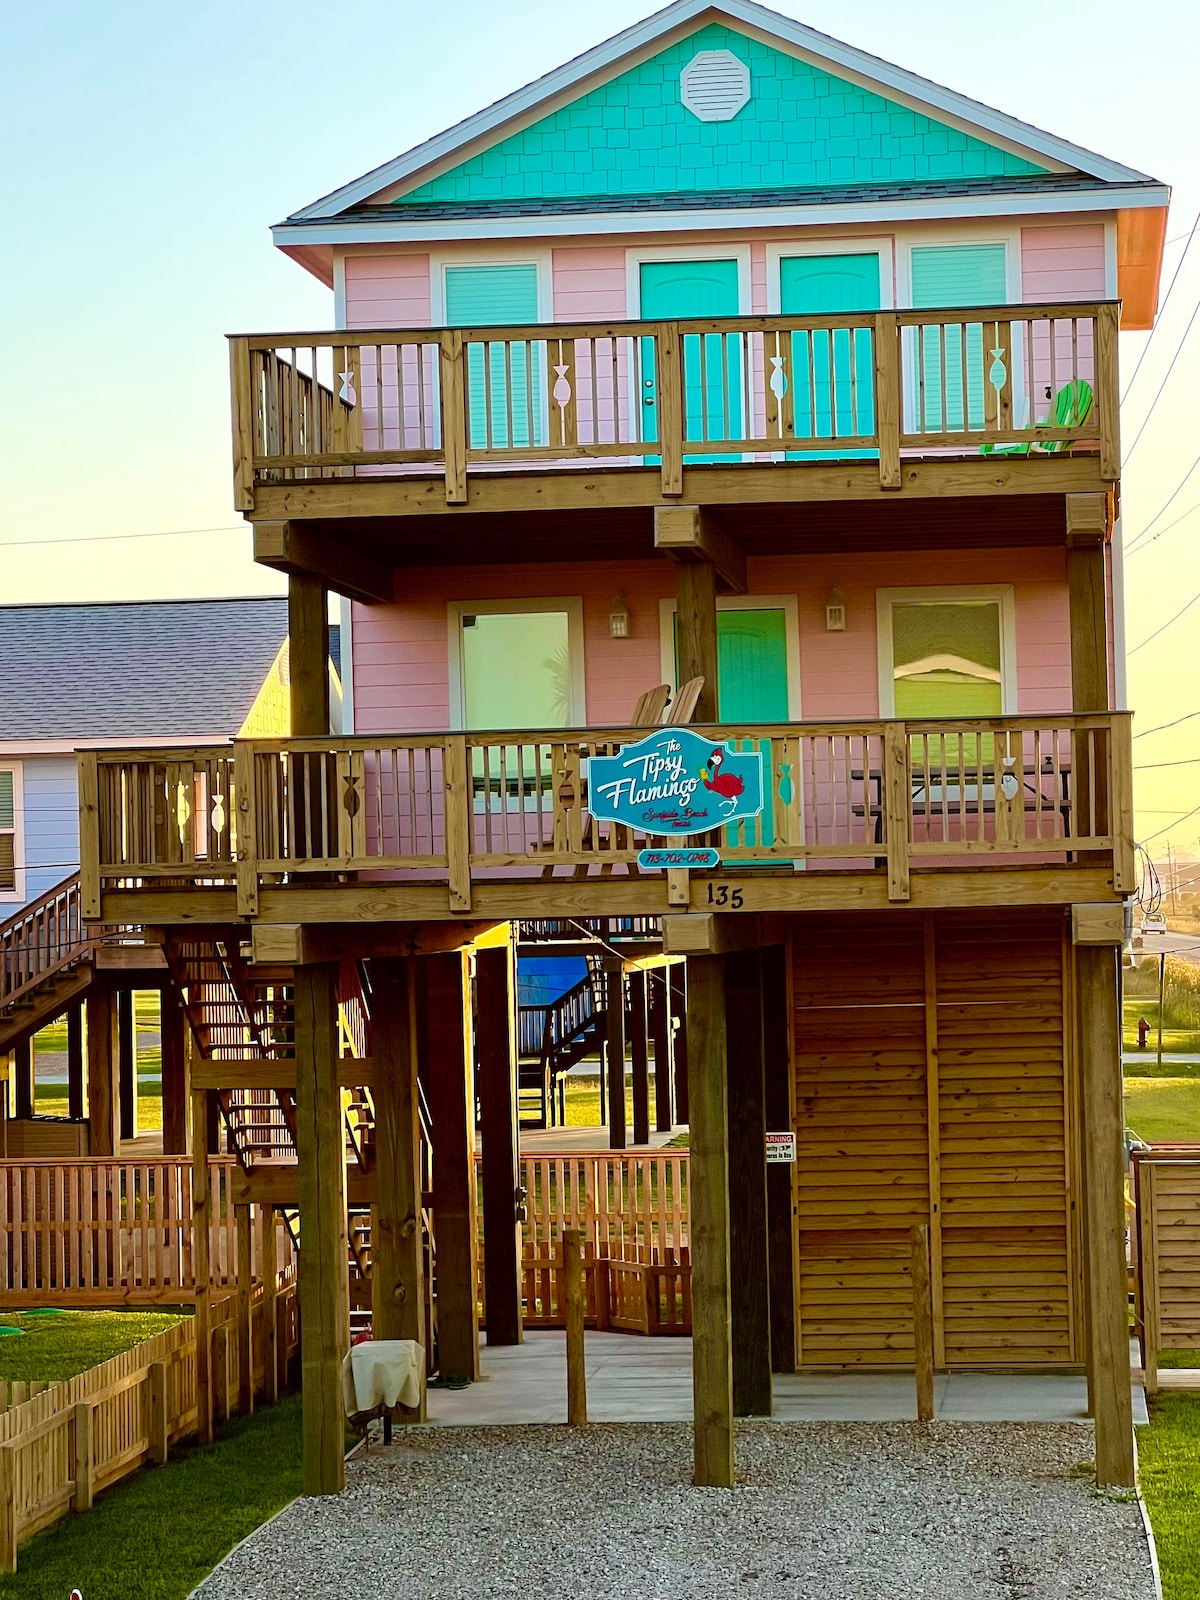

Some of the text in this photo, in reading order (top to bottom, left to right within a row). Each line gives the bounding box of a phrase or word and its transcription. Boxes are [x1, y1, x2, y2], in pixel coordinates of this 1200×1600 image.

[656, 738, 682, 755] The
[623, 752, 688, 783] Tipsy
[597, 776, 701, 809] Flamingo
[681, 808, 708, 820] Beach
[707, 882, 744, 909] 135
